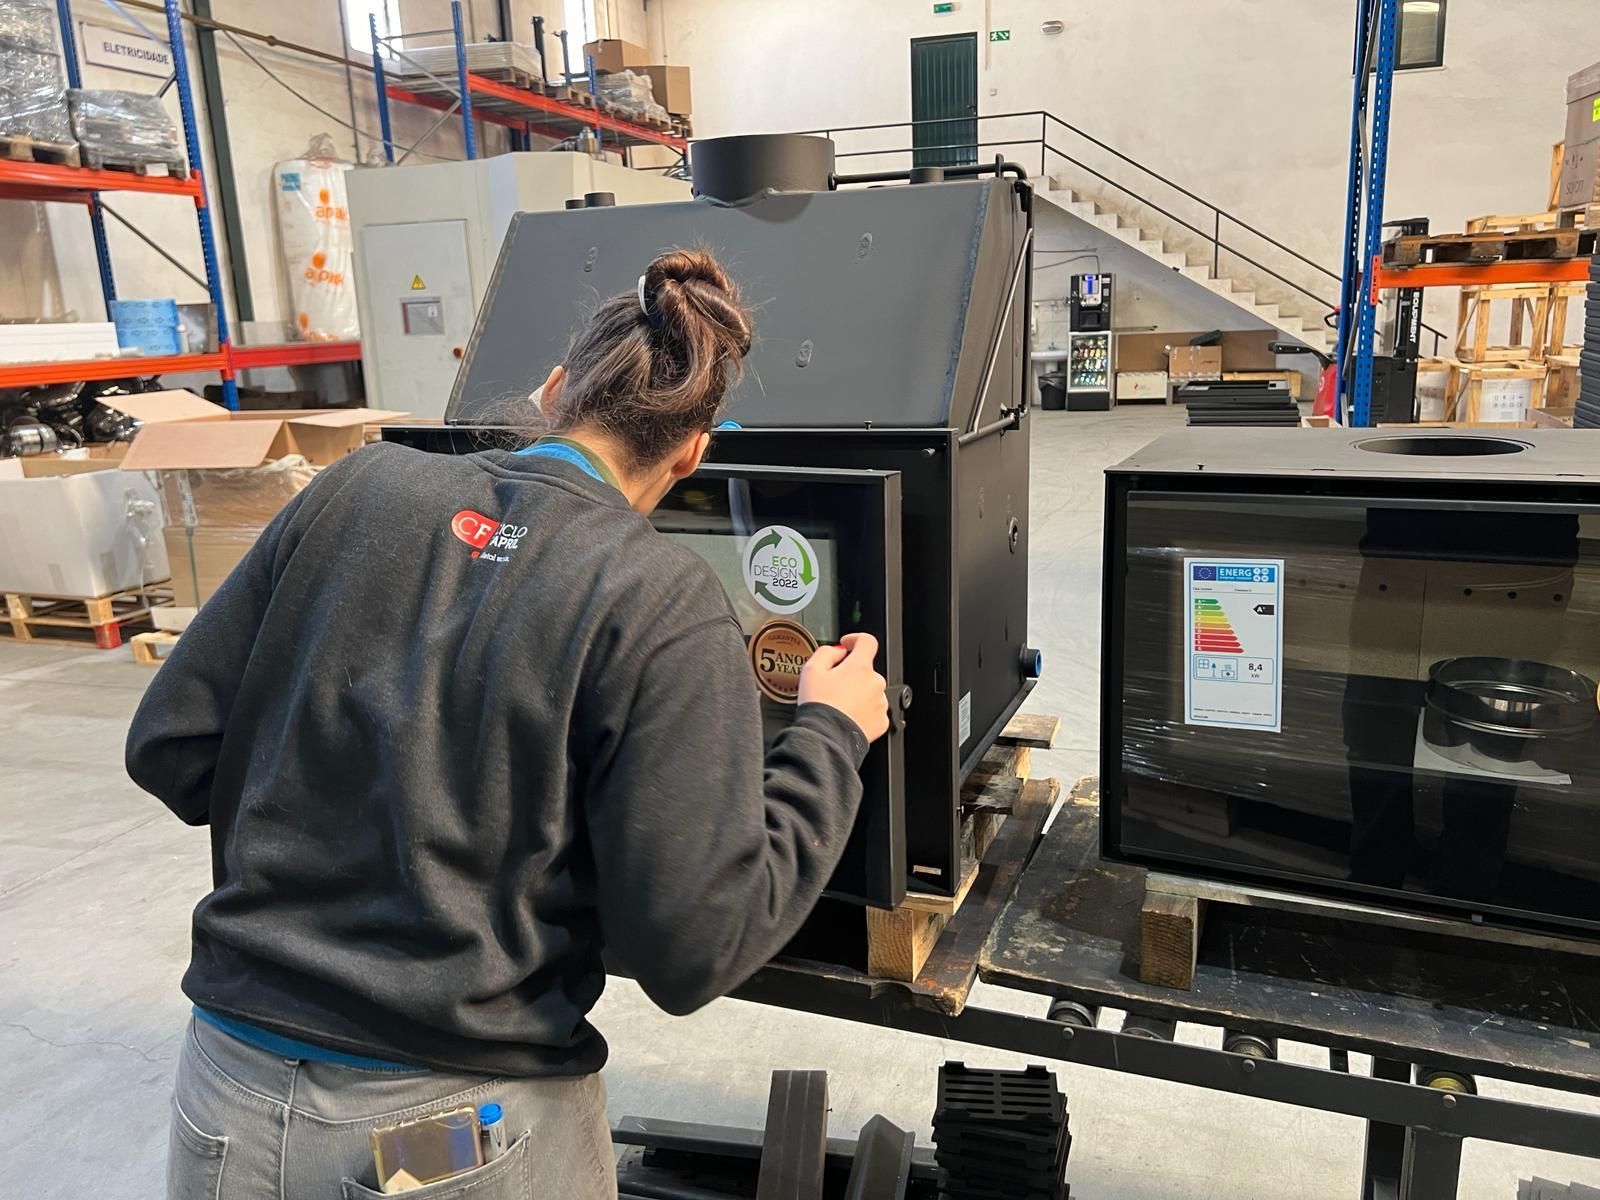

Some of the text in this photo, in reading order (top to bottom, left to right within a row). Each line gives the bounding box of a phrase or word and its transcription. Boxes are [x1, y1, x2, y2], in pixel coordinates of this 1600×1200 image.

[103, 42, 169, 64] ELETRICIDADE
[1409, 291, 1420, 343] EQUIPMENT
[458, 516, 492, 540] CF
[772, 556, 797, 568] ECO
[754, 565, 797, 579] DESIGN
[1219, 568, 1252, 577] ENERG
[772, 578, 798, 588] 2022
[760, 648, 775, 672] 5
[776, 663, 803, 675] YEA
[1248, 662, 1263, 672] 8,4
